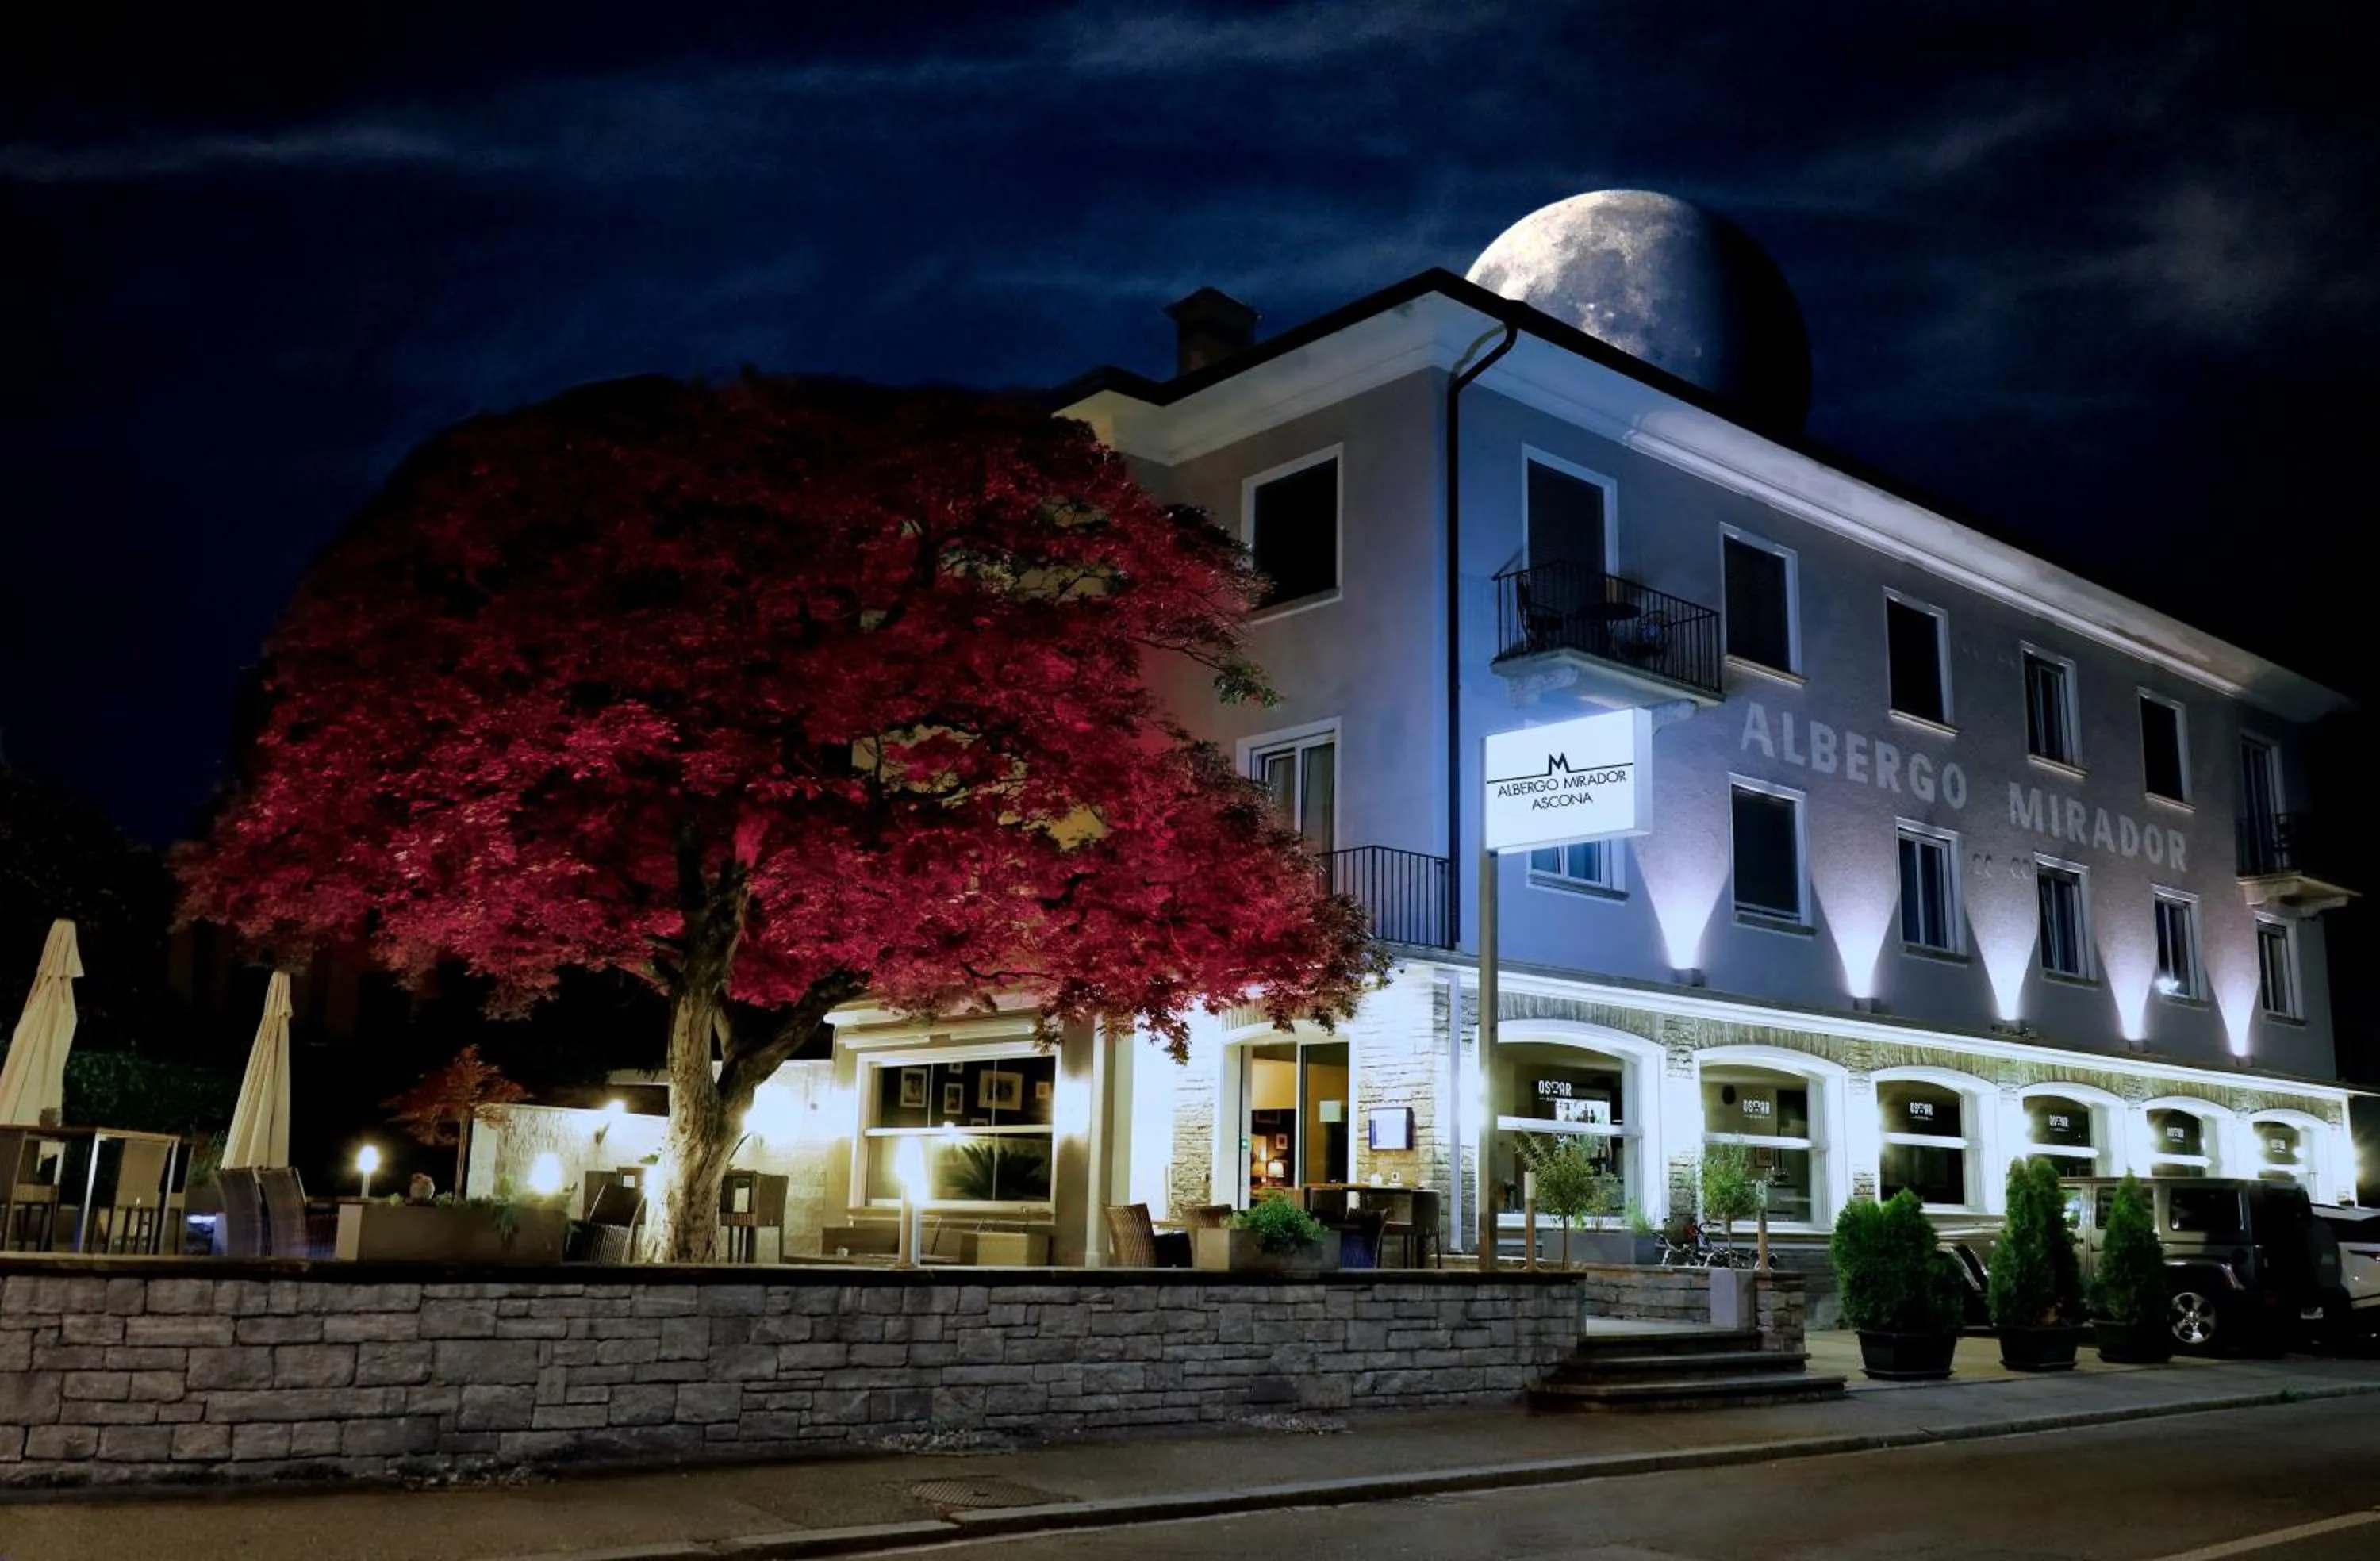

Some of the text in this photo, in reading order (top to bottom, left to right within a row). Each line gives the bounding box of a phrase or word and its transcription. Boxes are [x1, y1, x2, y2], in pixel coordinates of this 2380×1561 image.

[1548, 752, 1570, 776] M
[1498, 770, 1626, 798] ALBERGO MIRADOR
[1741, 702, 2187, 873] ALBERGO MIRADOR
[1532, 792, 1593, 811] ASCONA
